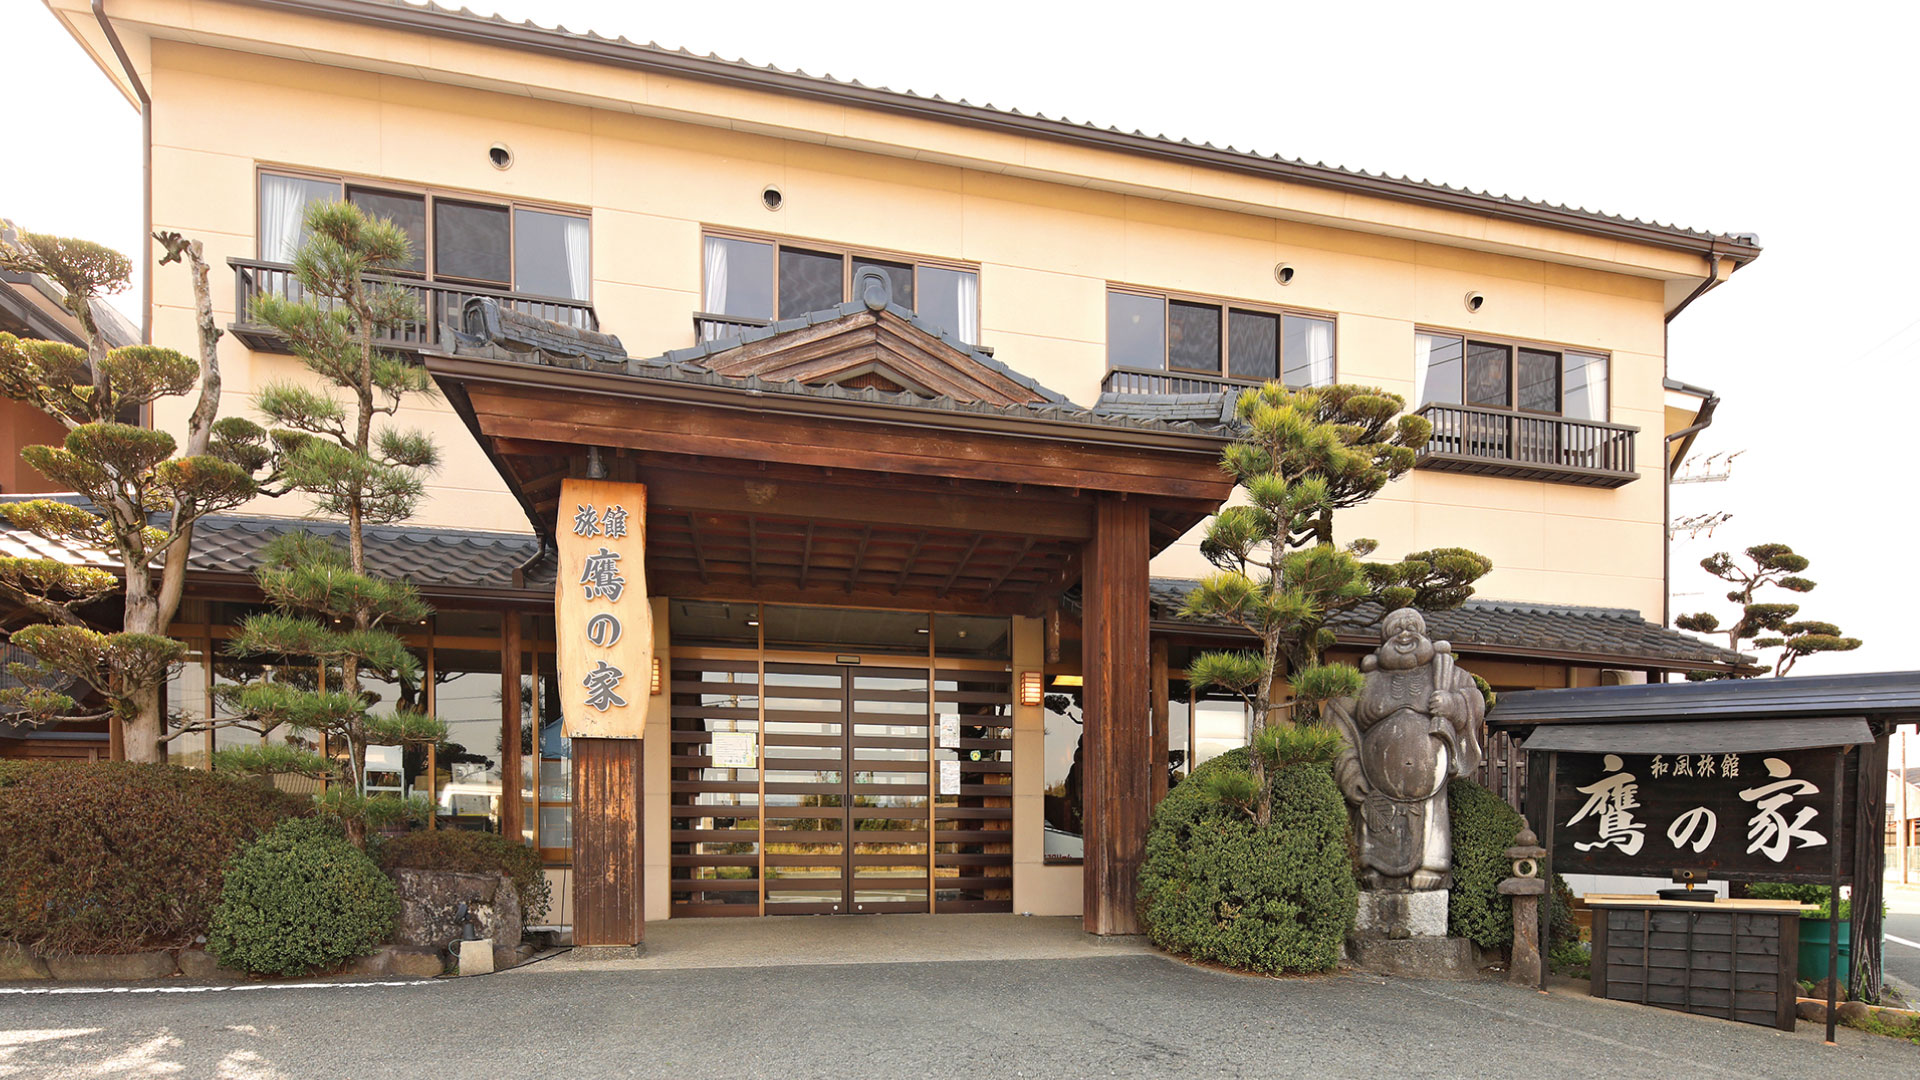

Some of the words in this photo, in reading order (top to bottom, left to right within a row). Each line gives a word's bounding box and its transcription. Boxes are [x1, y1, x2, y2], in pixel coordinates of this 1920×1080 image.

[574, 504, 628, 537] 旅館
[580, 548, 627, 711] 鷹の家
[1650, 754, 1740, 779] 和風旅館
[1566, 754, 1828, 862] 鷹の家
